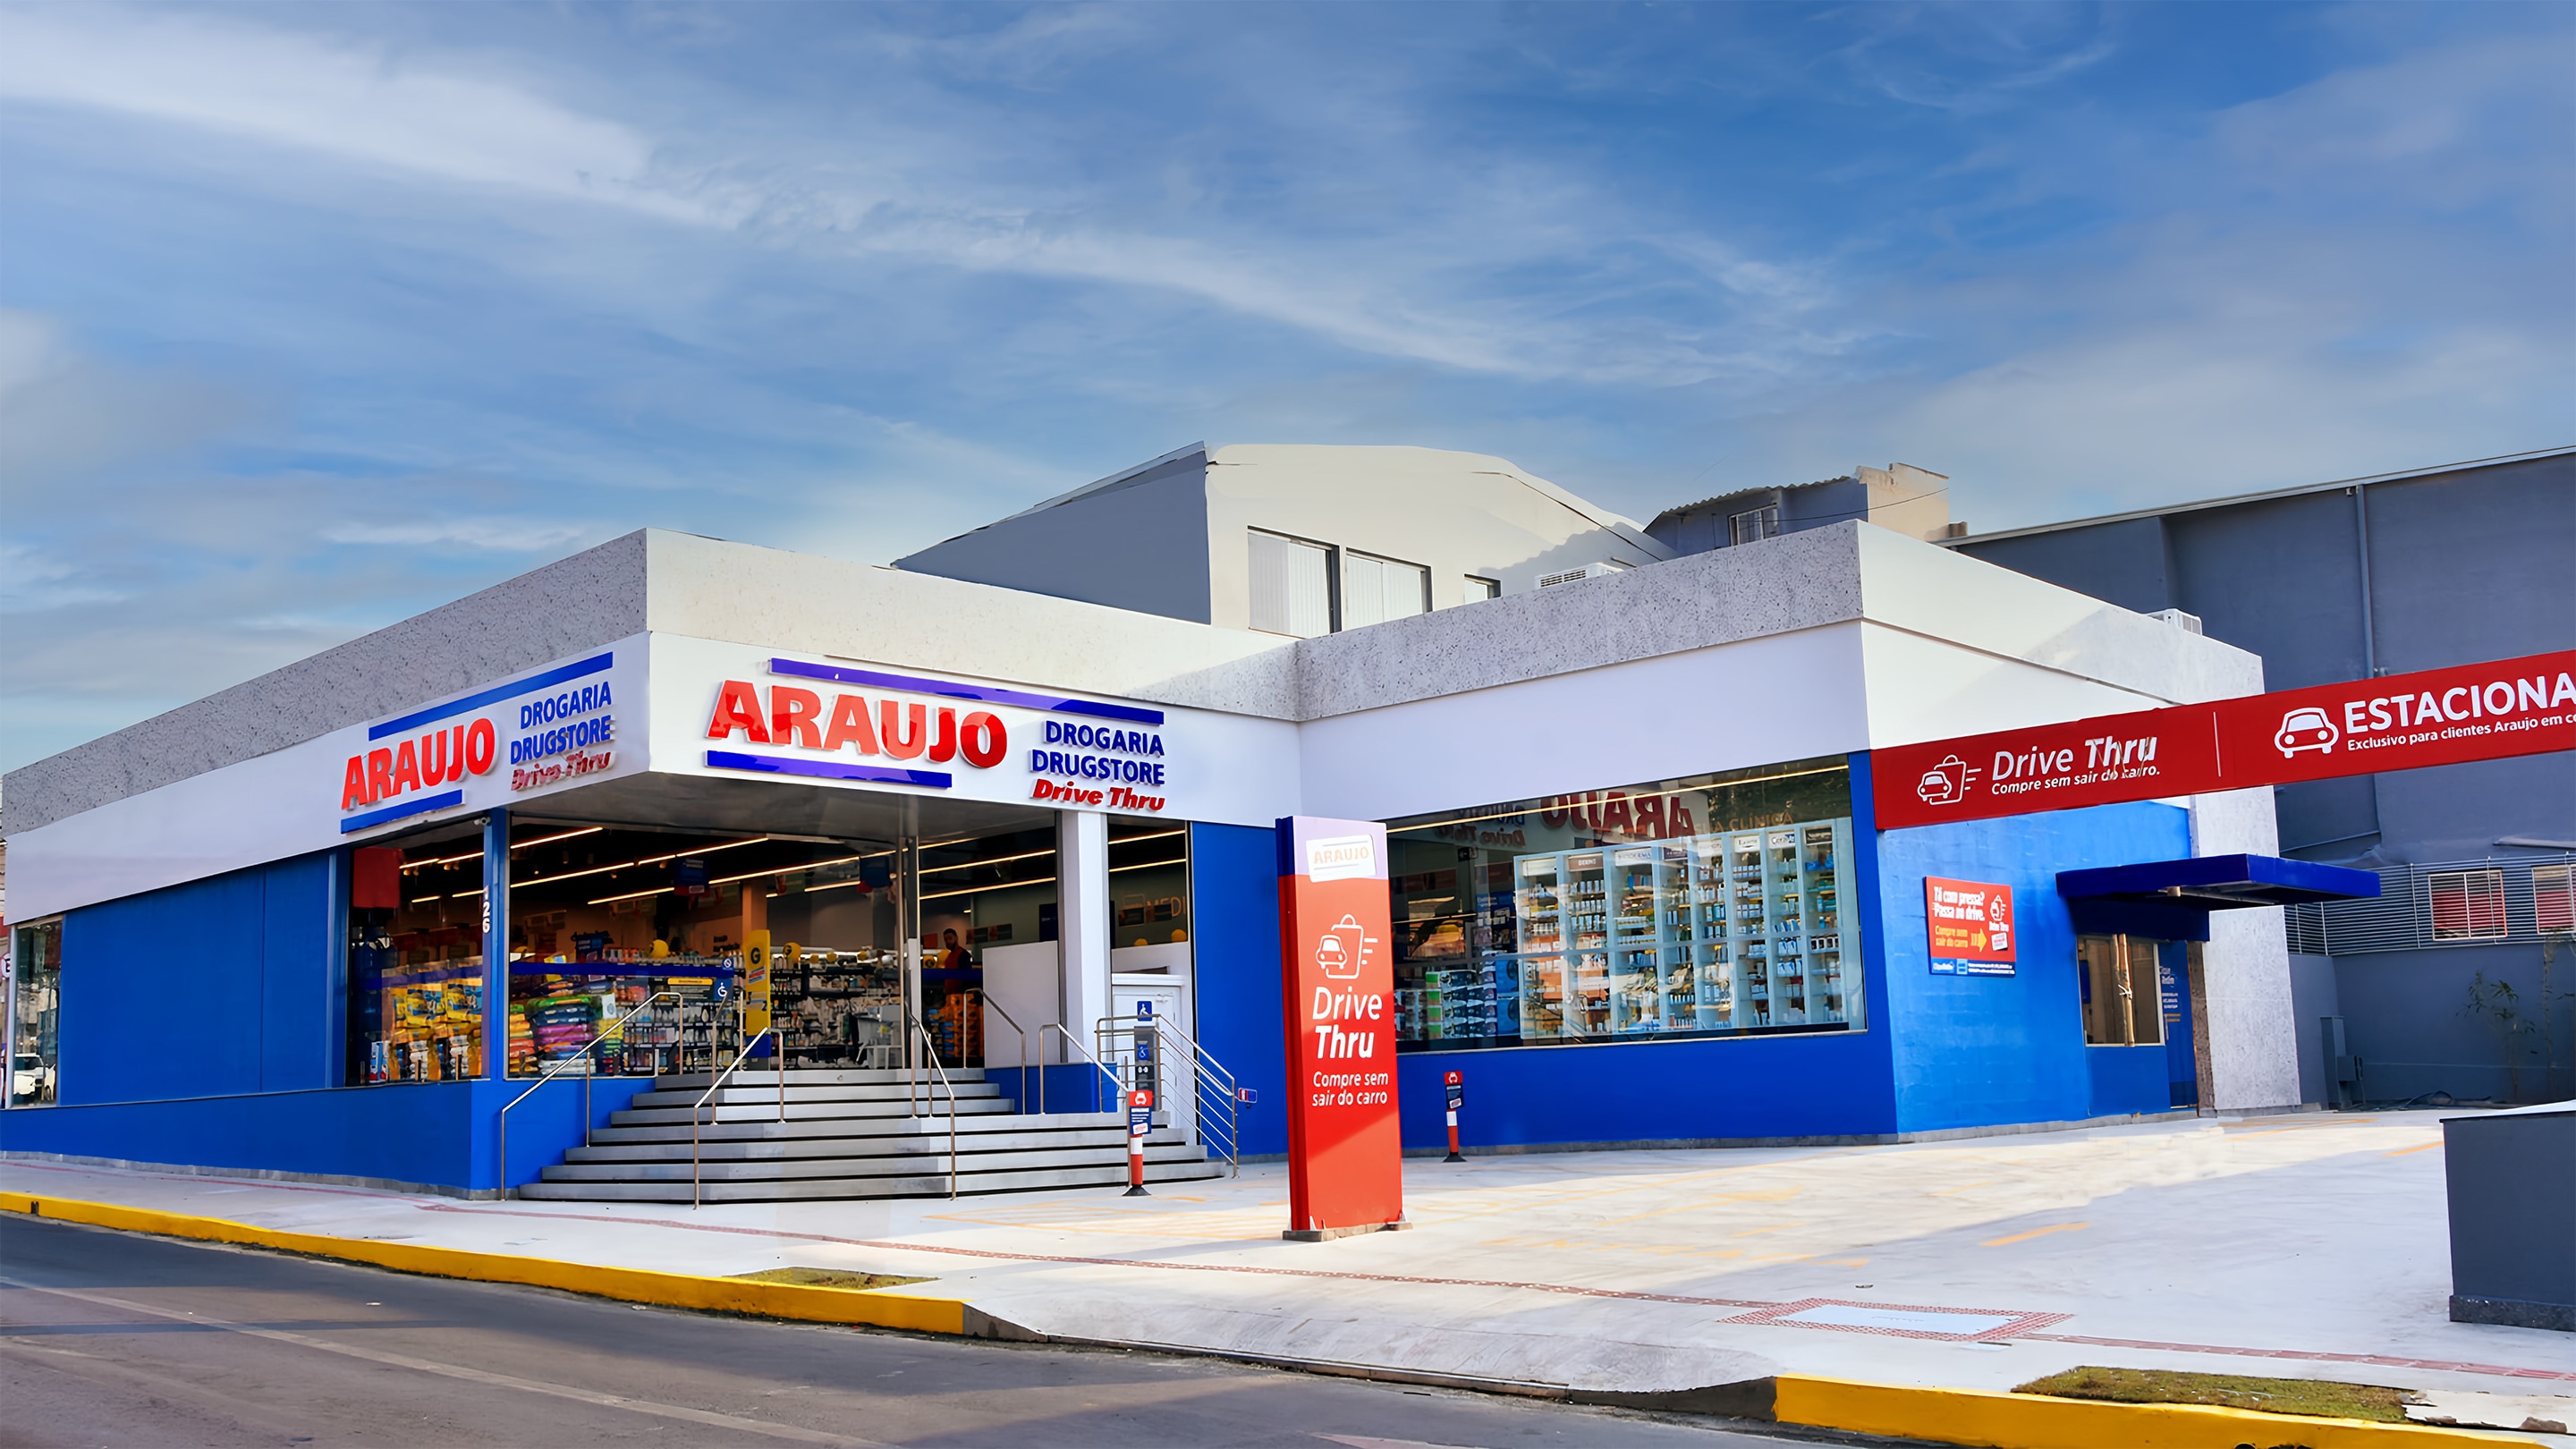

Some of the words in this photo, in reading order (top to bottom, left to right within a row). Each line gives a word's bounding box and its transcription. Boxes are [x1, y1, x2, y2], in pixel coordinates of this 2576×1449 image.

[521, 681, 612, 730] DROGARIA
[2344, 673, 2576, 734] ESTACIONA
[511, 715, 612, 765] DRUGSTORE
[707, 680, 1007, 768] ARAUJO
[1045, 720, 1165, 757] DROGARIA
[2348, 734, 2407, 750] Exclusivo
[2410, 731, 2438, 745] para
[2441, 724, 2491, 741] clientes
[2494, 716, 2538, 733] Araujo
[2541, 715, 2563, 727] em
[342, 717, 496, 810] ARAUJO
[511, 763, 562, 791] Drive
[566, 750, 612, 777] Thru
[1031, 749, 1165, 785] DRUGSTORE
[1992, 746, 2073, 781] Drive
[2084, 735, 2157, 769] Thru
[1032, 778, 1104, 805] Drive
[1108, 786, 1165, 811] Thru
[1991, 779, 2041, 795] Compre
[2044, 776, 2071, 789] sem
[2073, 771, 2097, 785] sair
[1314, 846, 1369, 865] ARAUJO
[1312, 985, 1383, 1021] Drive
[1315, 1024, 1375, 1059] Thru
[1311, 1089, 1335, 1106] sair
[1337, 1089, 1354, 1106] do
[1356, 1091, 1388, 1106] carro
[1313, 1071, 1362, 1089] Compre
[1364, 1072, 1389, 1087] sem
